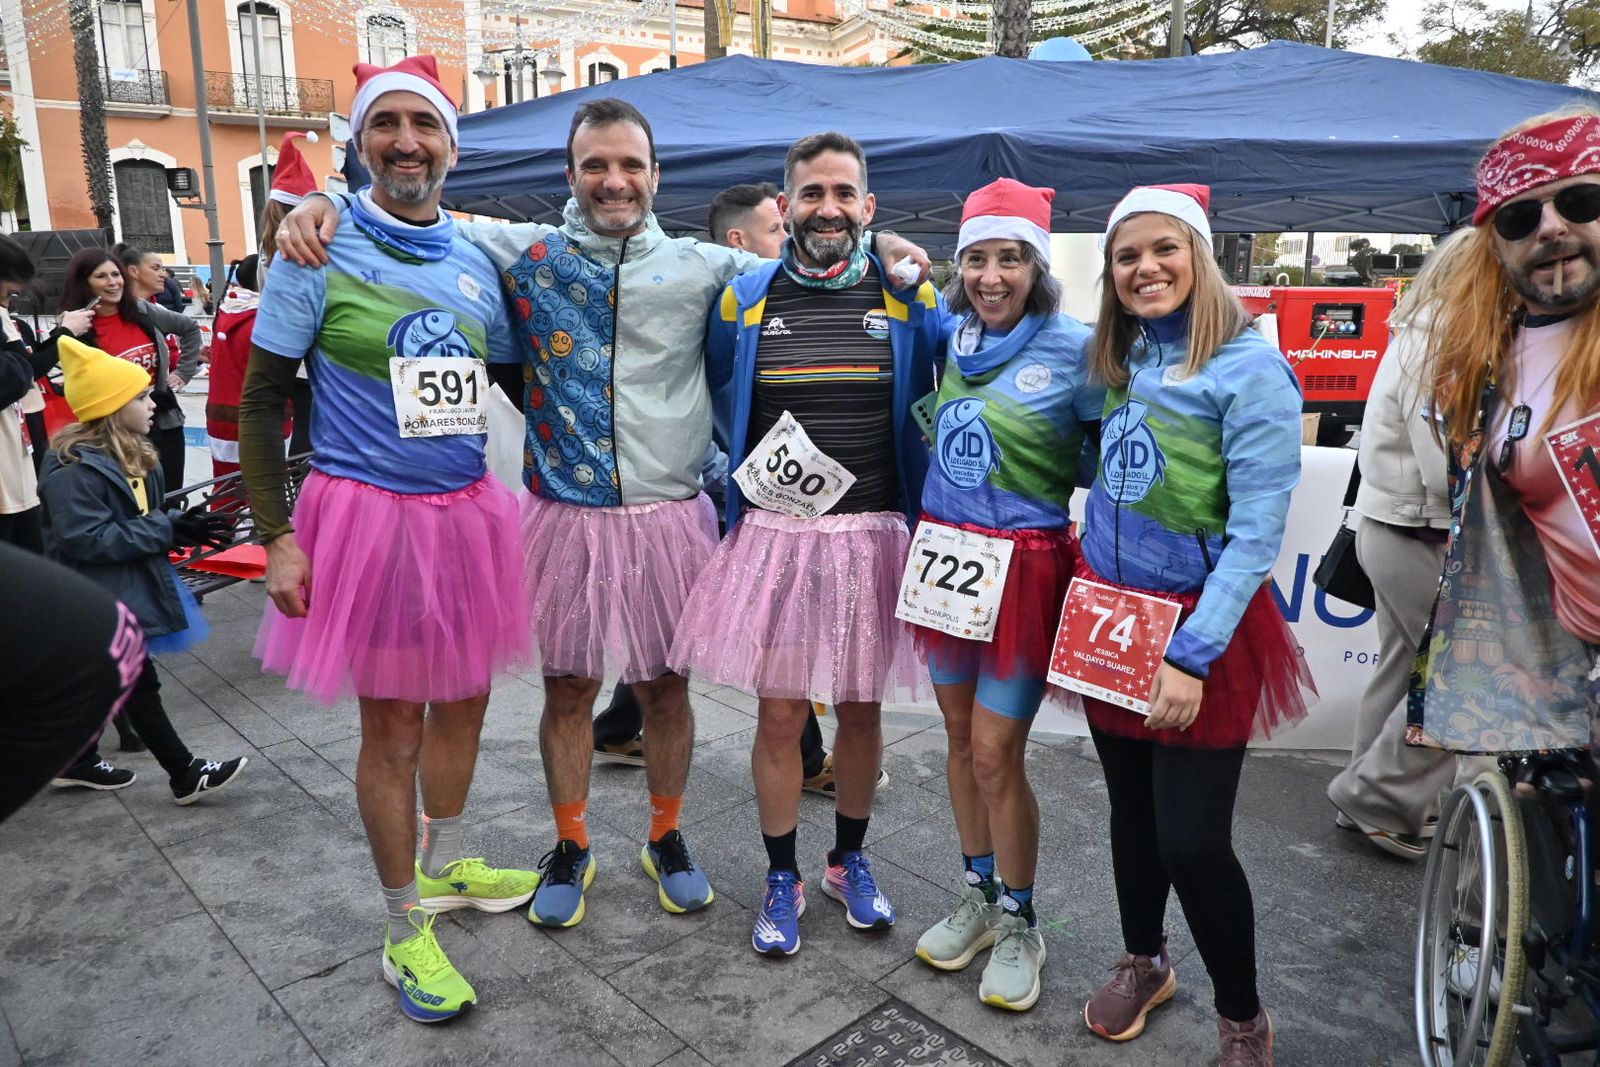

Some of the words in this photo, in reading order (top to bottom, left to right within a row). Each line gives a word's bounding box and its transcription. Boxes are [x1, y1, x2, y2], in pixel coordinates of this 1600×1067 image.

[1287, 350, 1377, 360] MAKINSUR
[418, 370, 477, 407] 591
[404, 418, 456, 430] POMARES
[955, 431, 984, 458] JD
[766, 443, 826, 496] 590
[919, 549, 985, 598] 722
[1088, 605, 1137, 653] 74
[1073, 650, 1106, 667] VALDAYO
[1106, 660, 1136, 676] SUAREZ
[1094, 647, 1119, 660] JESSICA
